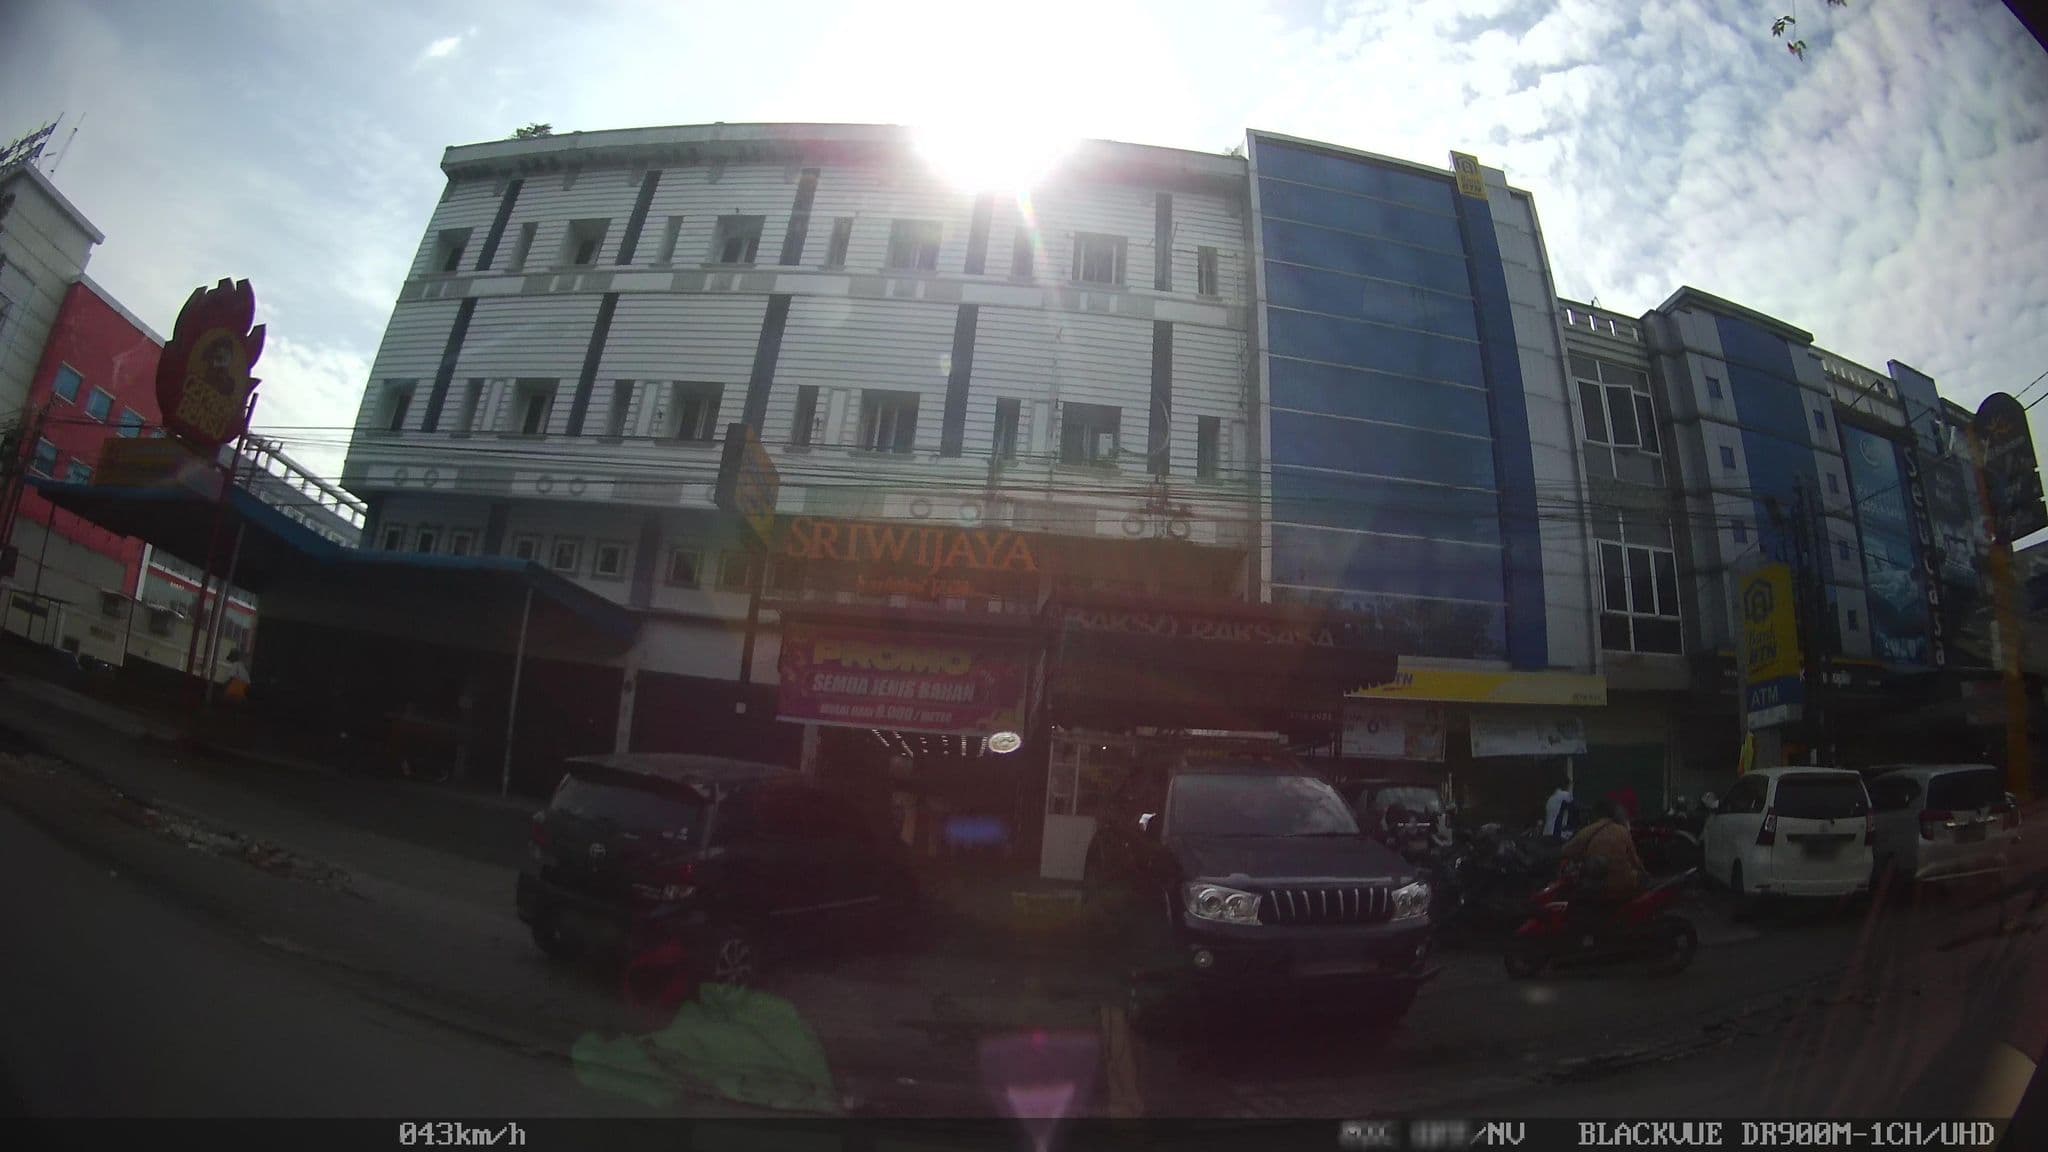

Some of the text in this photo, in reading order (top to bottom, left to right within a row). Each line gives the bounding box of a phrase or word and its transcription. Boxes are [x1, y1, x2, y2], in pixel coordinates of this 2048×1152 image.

[787, 518, 1041, 576] SRIWIJAYA
[812, 639, 972, 675] PROMO
[870, 677, 915, 699] JENIS
[1752, 685, 1779, 706] ATM
